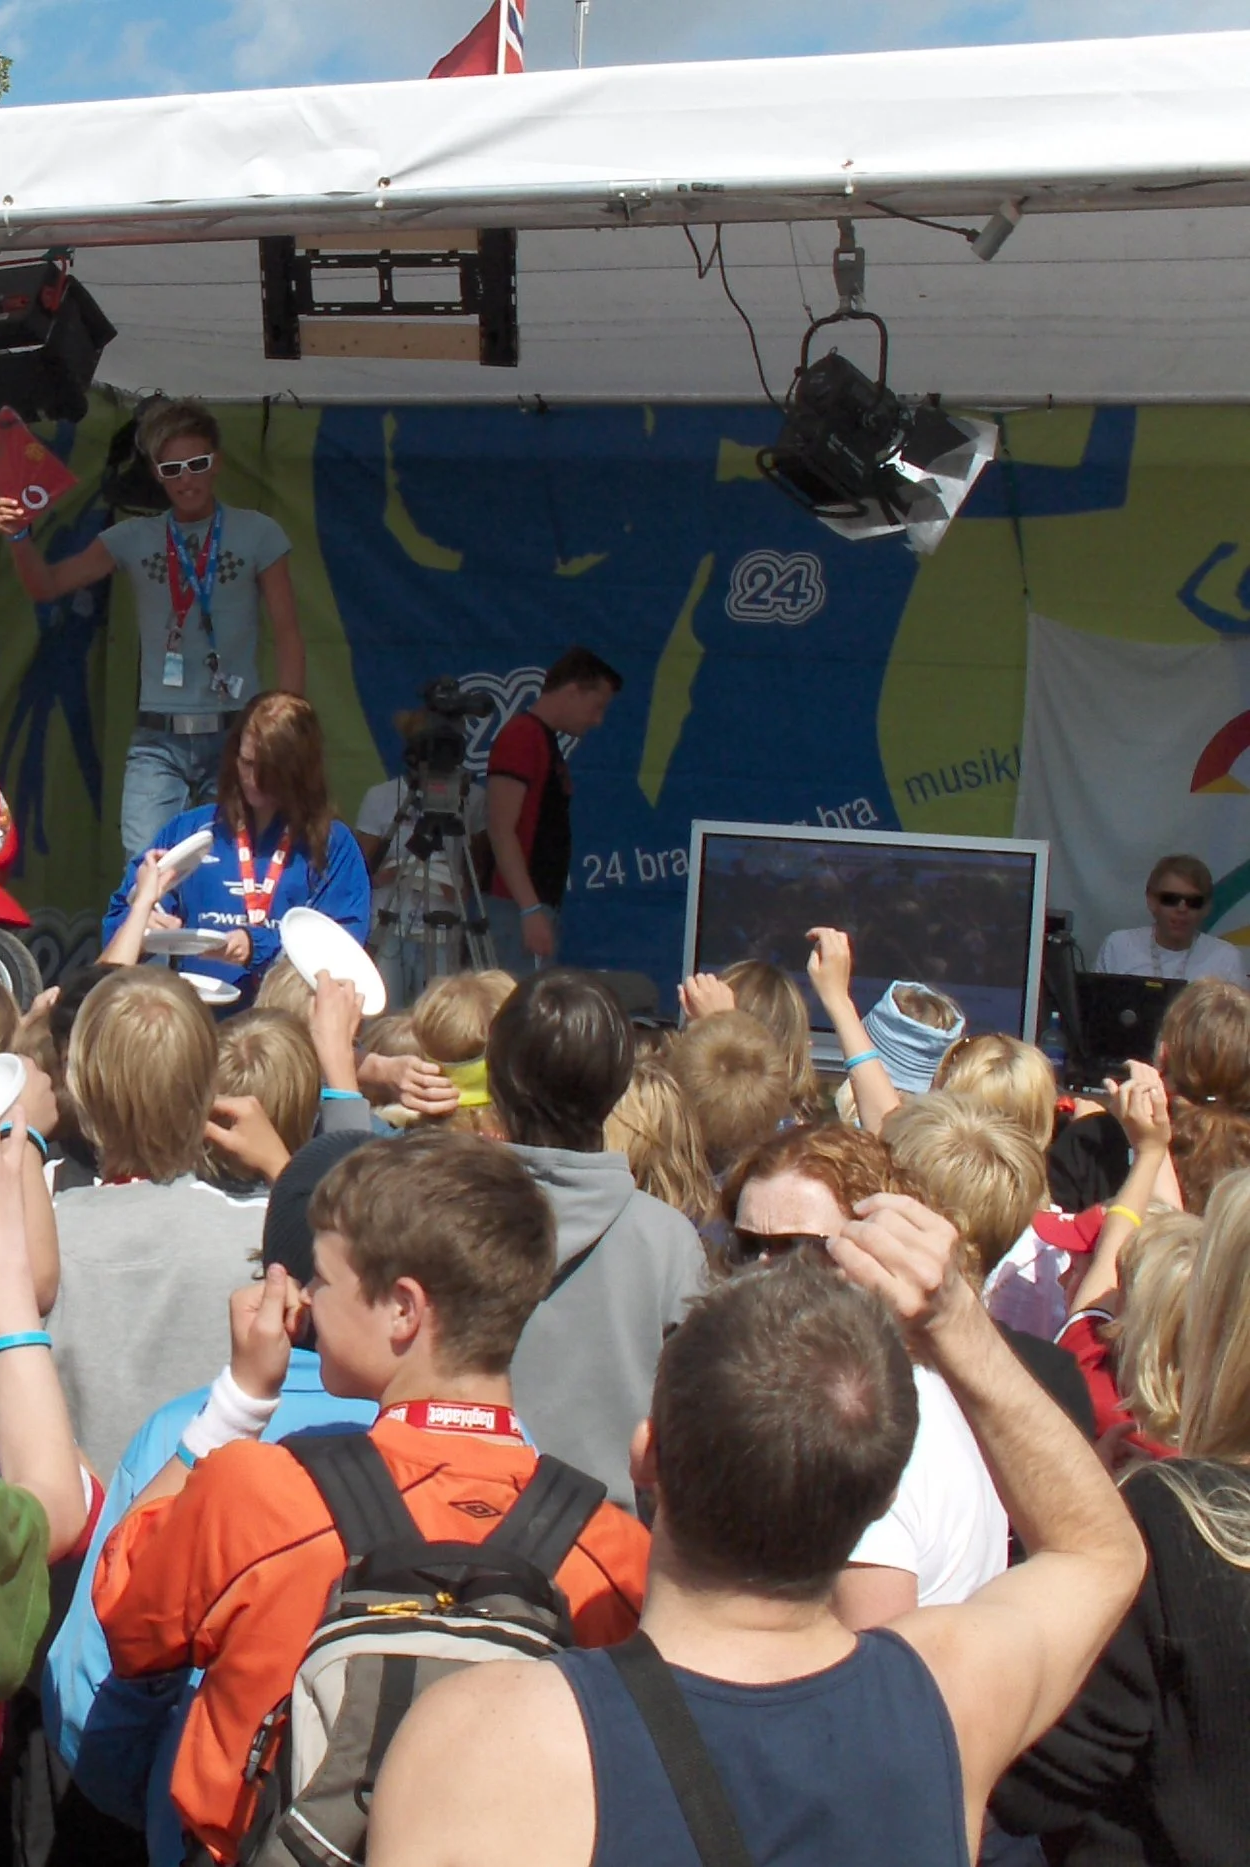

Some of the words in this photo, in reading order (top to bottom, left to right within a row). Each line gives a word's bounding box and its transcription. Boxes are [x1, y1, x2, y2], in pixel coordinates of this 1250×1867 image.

[736, 561, 815, 612] 24
[582, 851, 626, 890] 24
[635, 847, 691, 882] bra
[429, 1407, 495, 1430] Dagbladet
